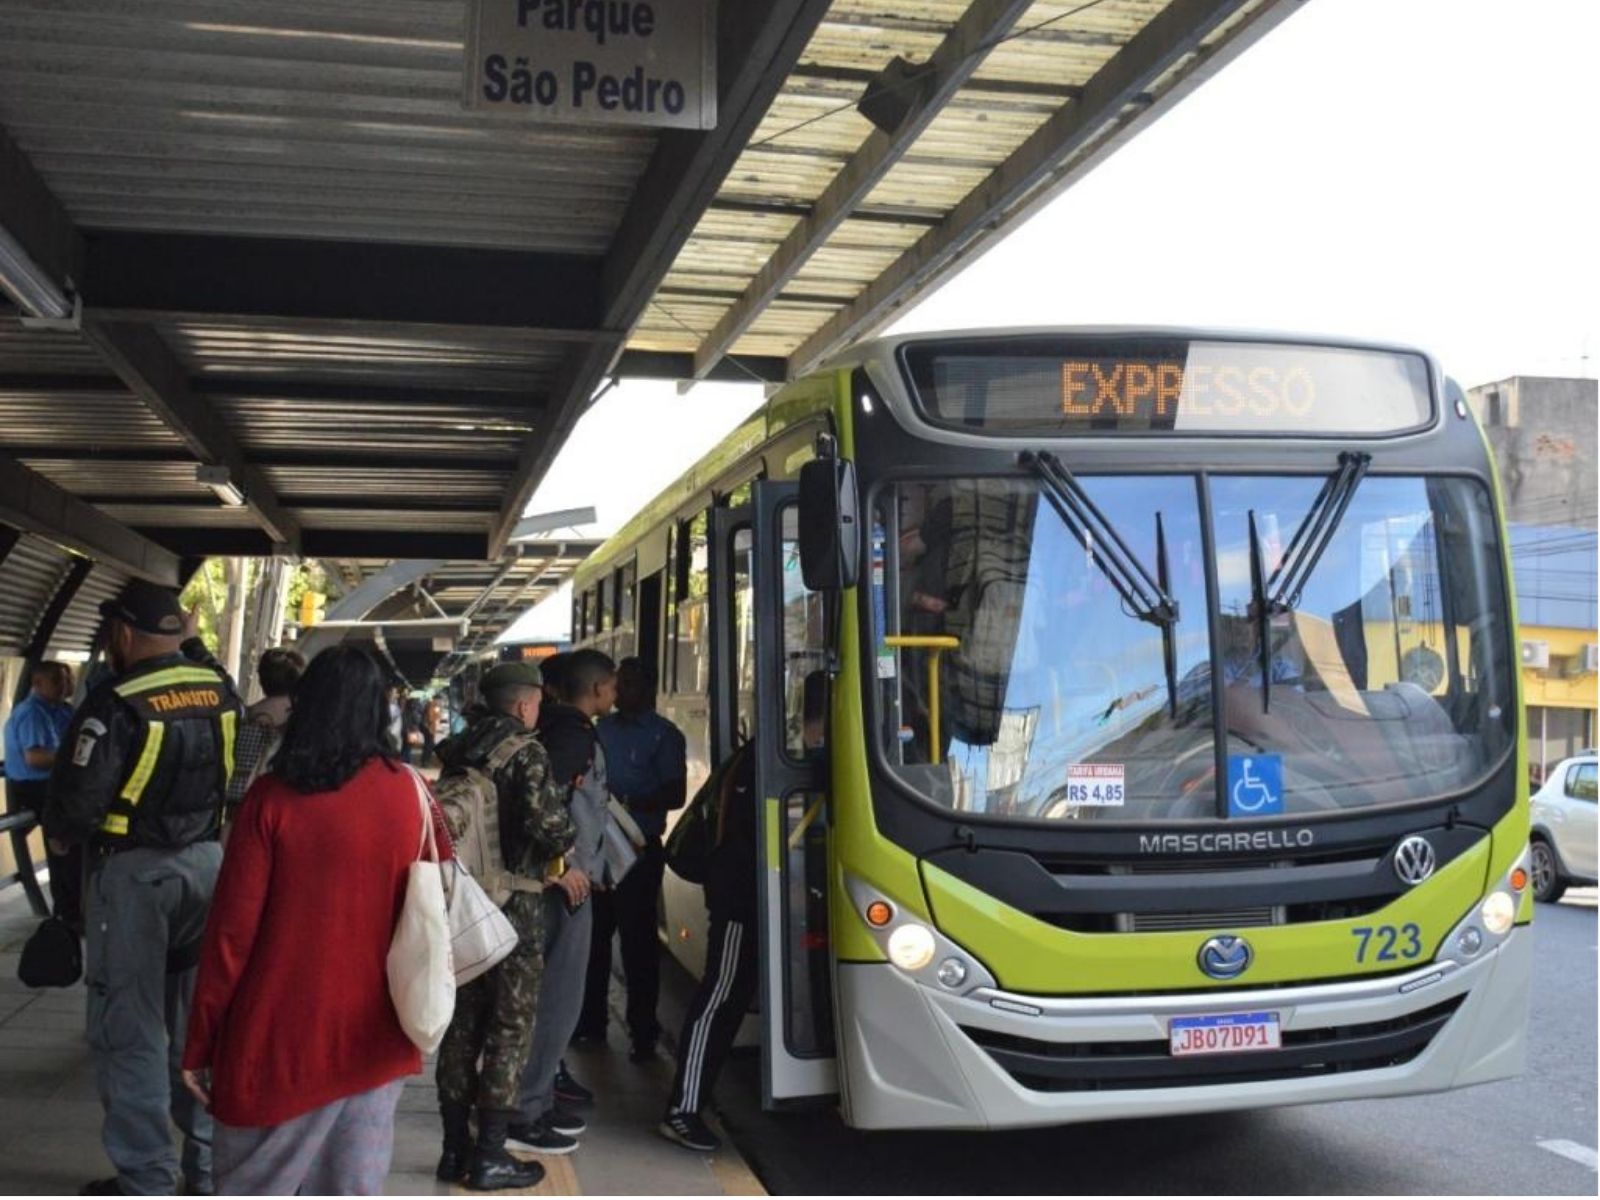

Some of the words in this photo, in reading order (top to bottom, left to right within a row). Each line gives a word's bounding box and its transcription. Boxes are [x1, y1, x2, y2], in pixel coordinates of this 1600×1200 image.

[517, 0, 655, 45] Parque
[483, 54, 558, 106] São
[572, 61, 685, 115] Pedro
[1062, 361, 1315, 417] EXPRESSO
[1092, 784, 1122, 803] 4,85
[1139, 829, 1314, 853] MASCARELLO
[1352, 922, 1422, 964] 723
